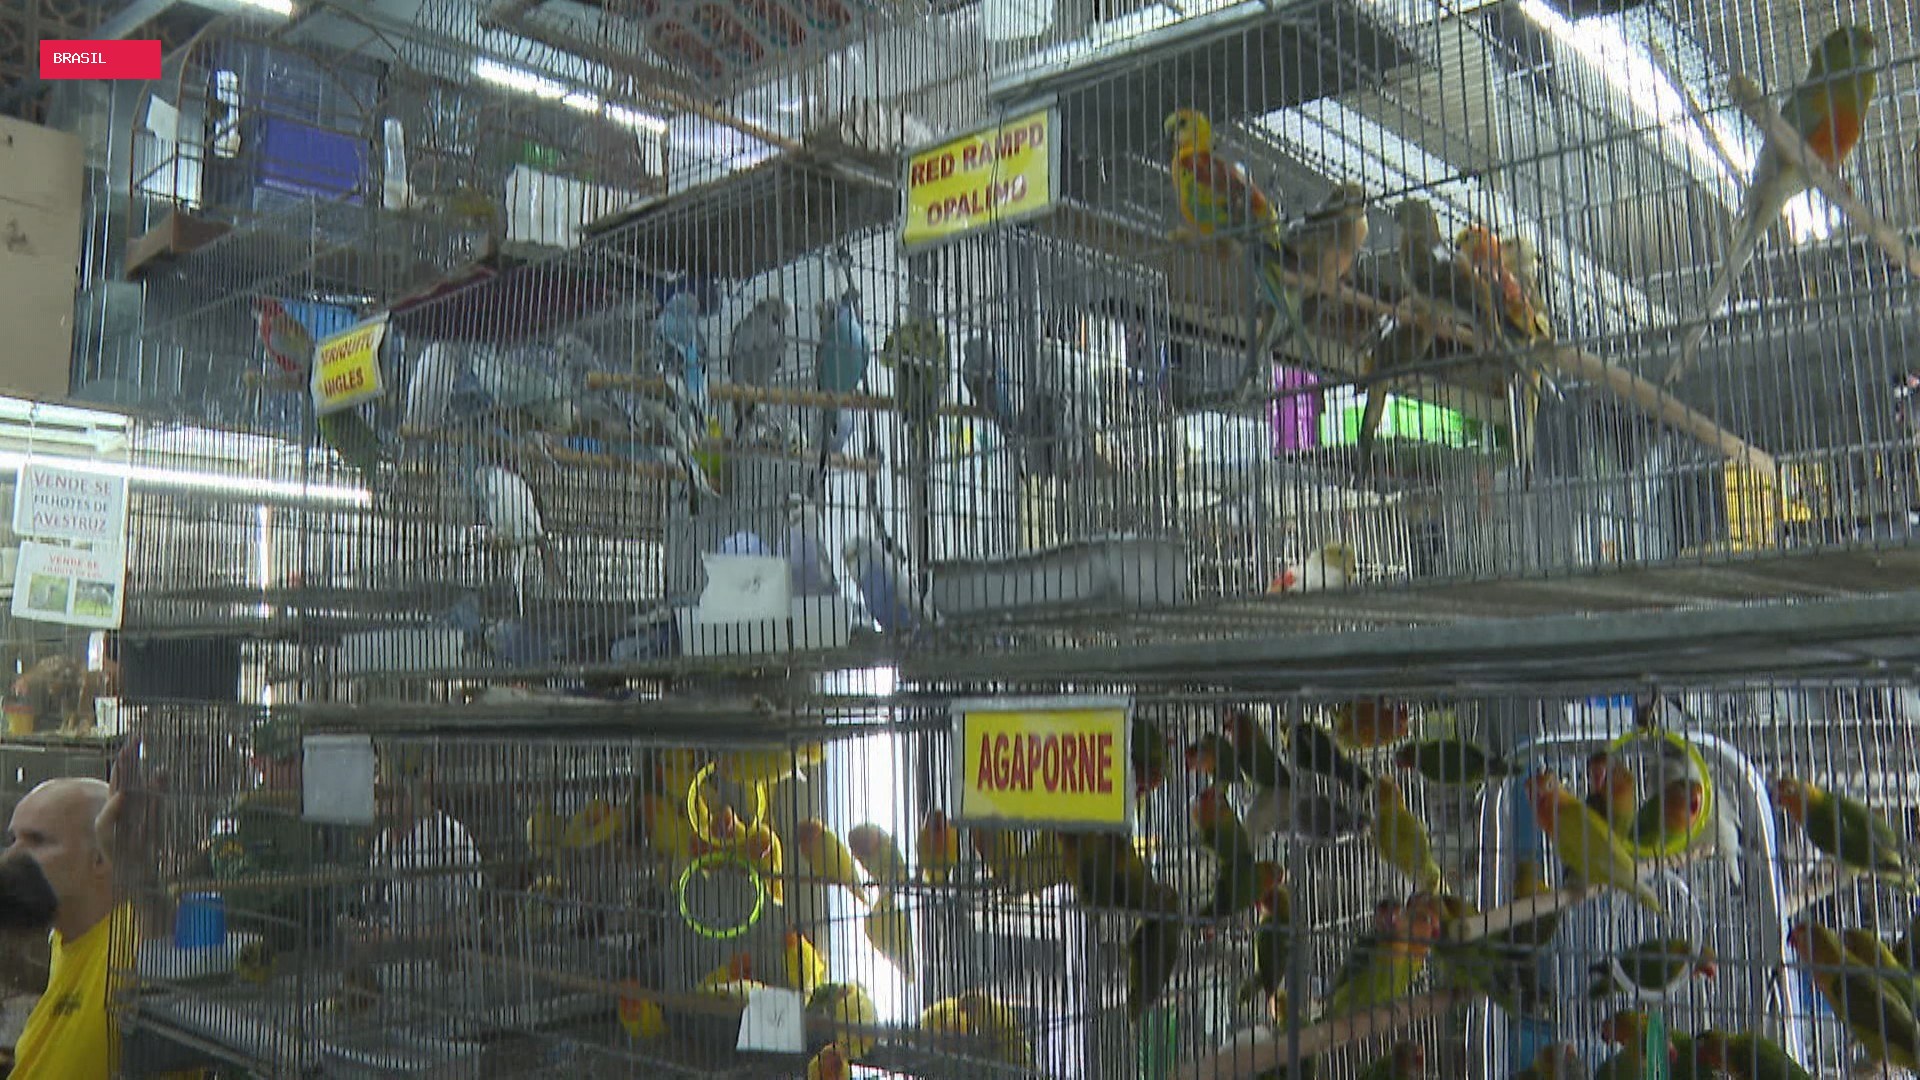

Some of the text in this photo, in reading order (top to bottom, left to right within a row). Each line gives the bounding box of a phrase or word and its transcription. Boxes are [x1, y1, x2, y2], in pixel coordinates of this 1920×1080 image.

[911, 121, 1044, 188] RED RAMPD
[927, 174, 1027, 226] OPALINO
[34, 470, 110, 497] VENDE SE
[33, 510, 107, 532] AVESTRUZ
[34, 494, 109, 513] FILHOTES DE
[977, 731, 1113, 795] AGAPORNE
